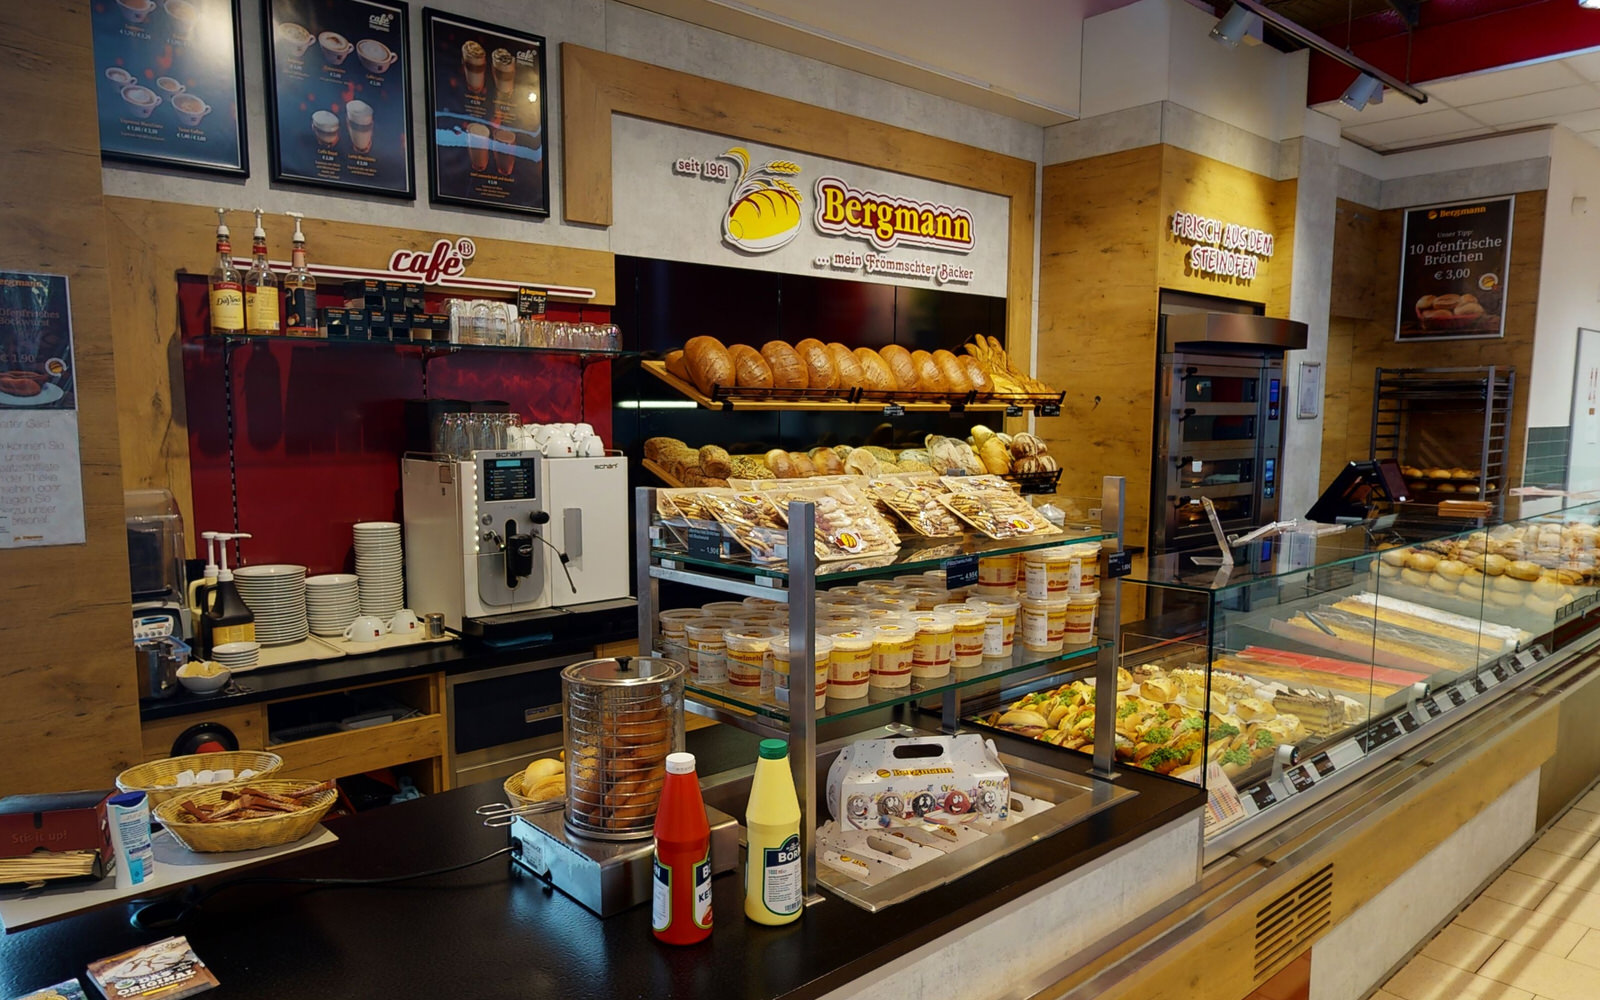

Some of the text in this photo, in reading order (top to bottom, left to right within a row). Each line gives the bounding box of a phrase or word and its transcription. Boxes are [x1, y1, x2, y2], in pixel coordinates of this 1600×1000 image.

[678, 160, 730, 178] seit 1961
[822, 186, 971, 242] Bergmann
[1440, 205, 1487, 218] Bergmann
[1174, 211, 1273, 255] FRISCH AUS DEM
[1410, 237, 1502, 255] 10 ofenfrische
[391, 241, 464, 283] café
[834, 252, 862, 266] mein
[939, 263, 974, 280] Bäcker
[1191, 246, 1257, 277] STEINOFEN
[1424, 251, 1483, 266] Brötchen
[1434, 268, 1471, 280] € 3,00
